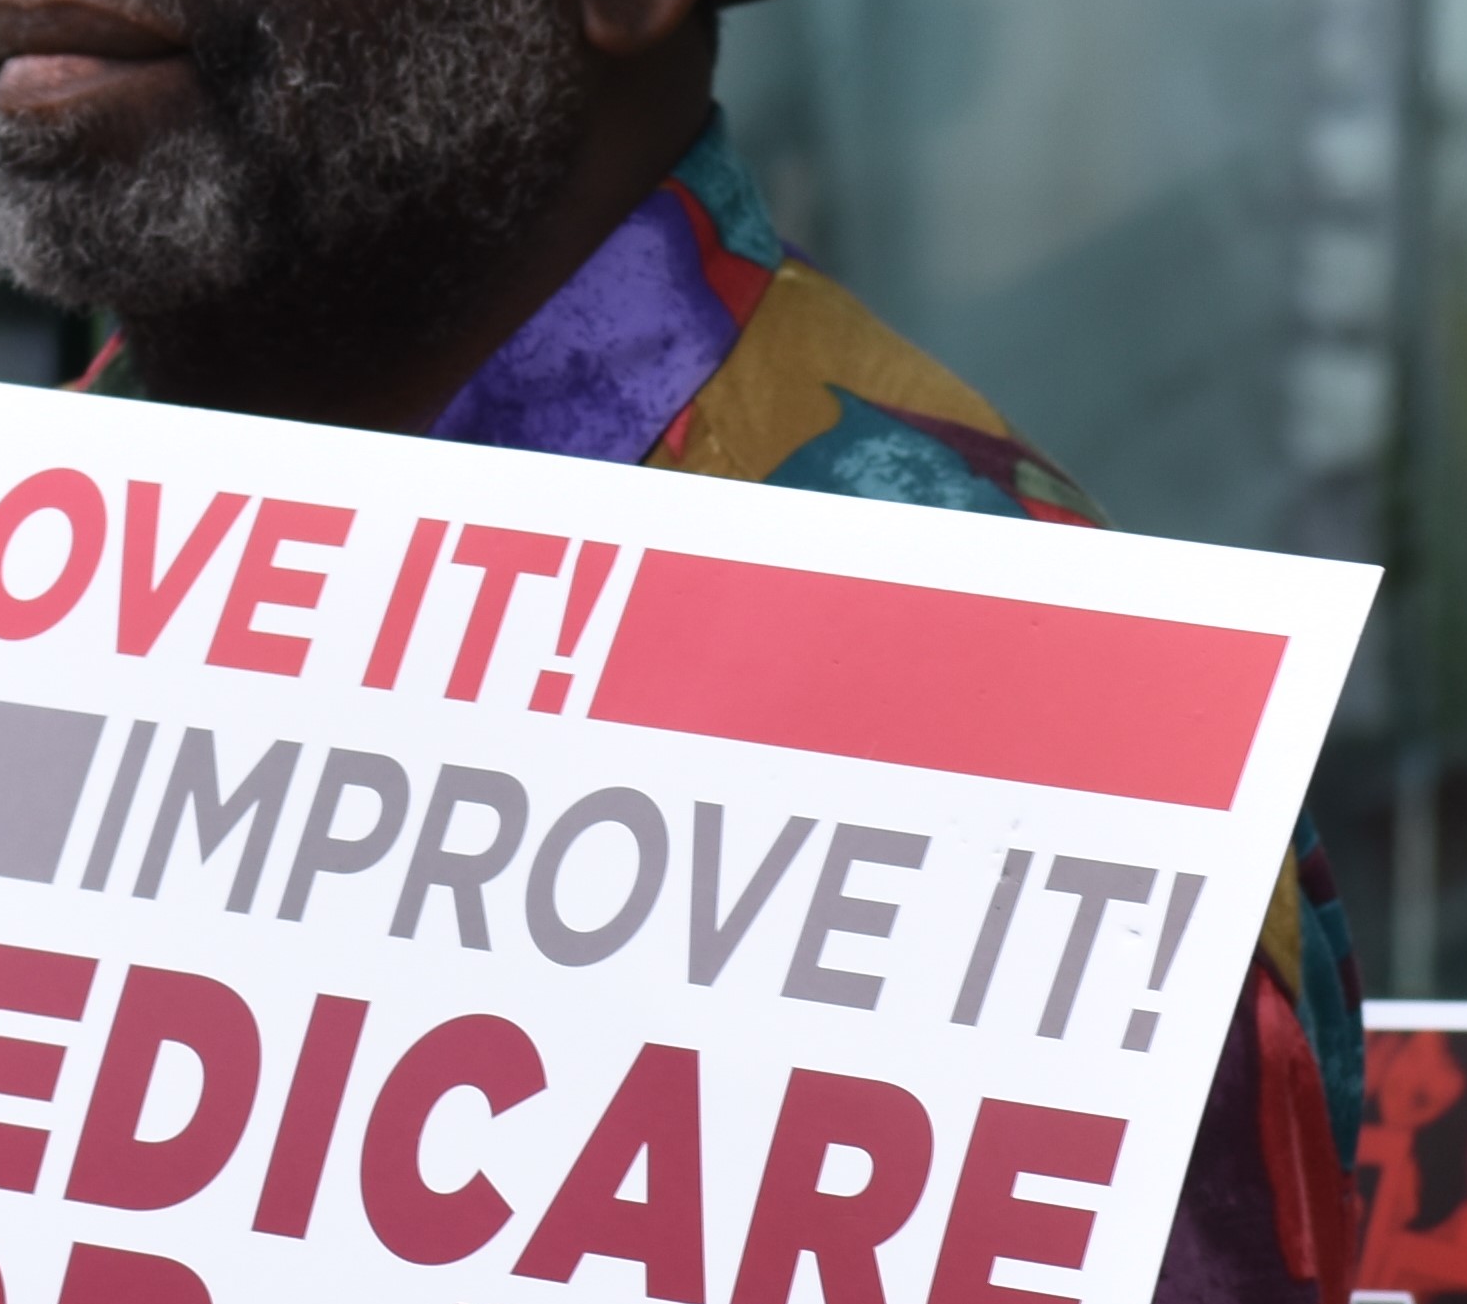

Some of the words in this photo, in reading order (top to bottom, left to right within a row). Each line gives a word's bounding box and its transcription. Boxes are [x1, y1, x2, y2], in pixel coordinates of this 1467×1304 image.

[361, 518, 620, 715] IT!
[81, 720, 930, 1010] IMPROVE
[950, 849, 1205, 1052] IT!
